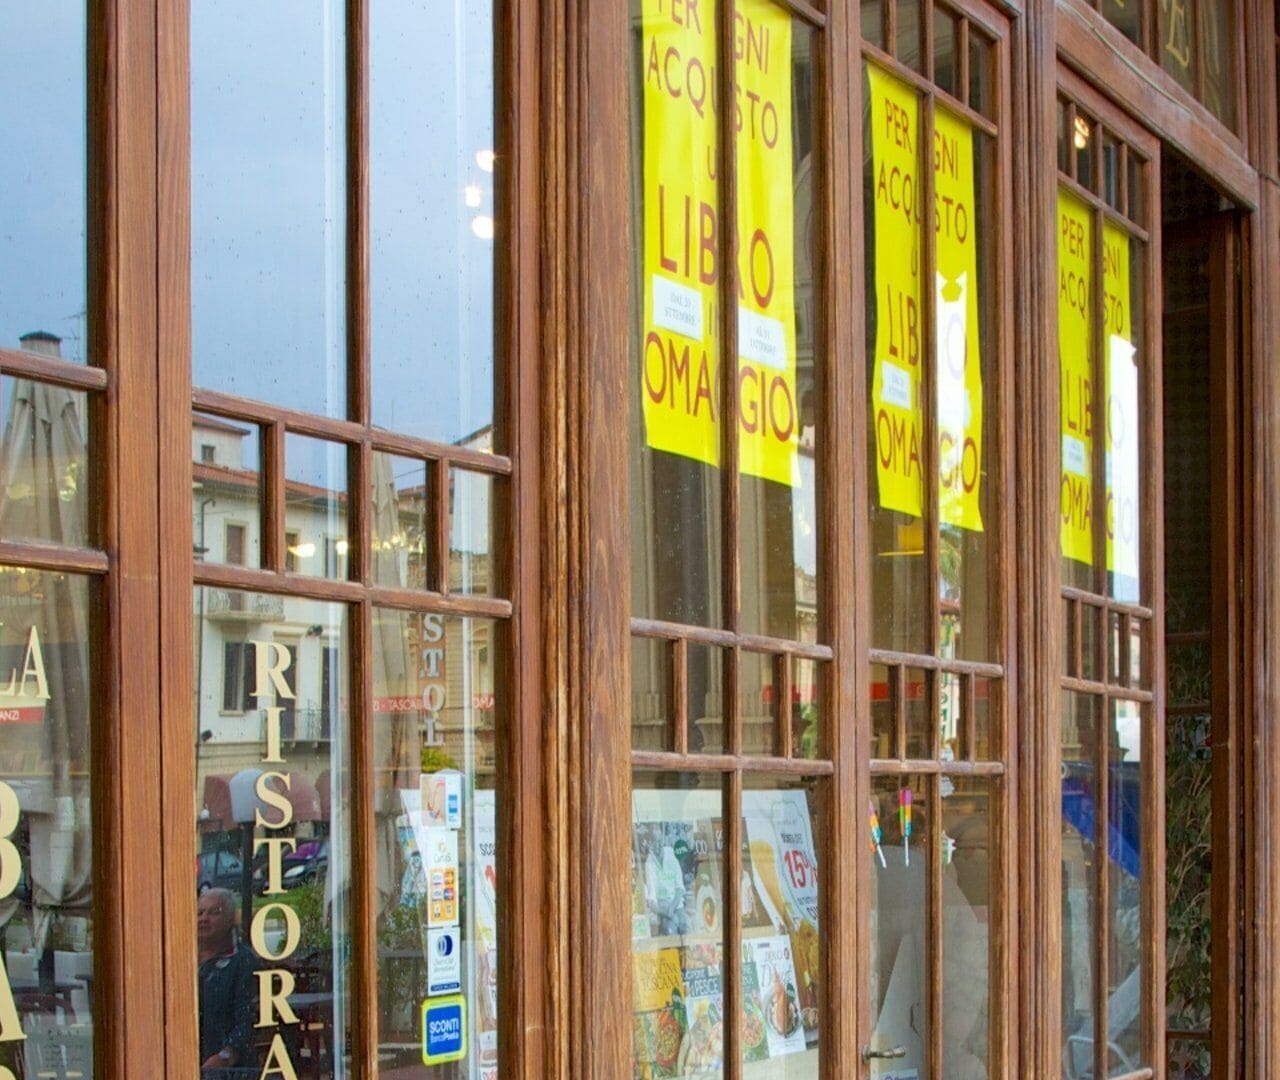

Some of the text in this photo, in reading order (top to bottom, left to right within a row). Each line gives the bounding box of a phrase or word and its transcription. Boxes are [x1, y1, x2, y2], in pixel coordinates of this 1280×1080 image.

[733, 10, 770, 75] GNI
[885, 98, 959, 180] PER GNI
[658, 184, 775, 309] LIBO
[1062, 214, 1085, 260] PER
[888, 284, 967, 380] LIBO
[645, 331, 794, 442] OMAGIO
[877, 408, 979, 494] OMAGIO
[429, 1017, 460, 1034] SCONTI
